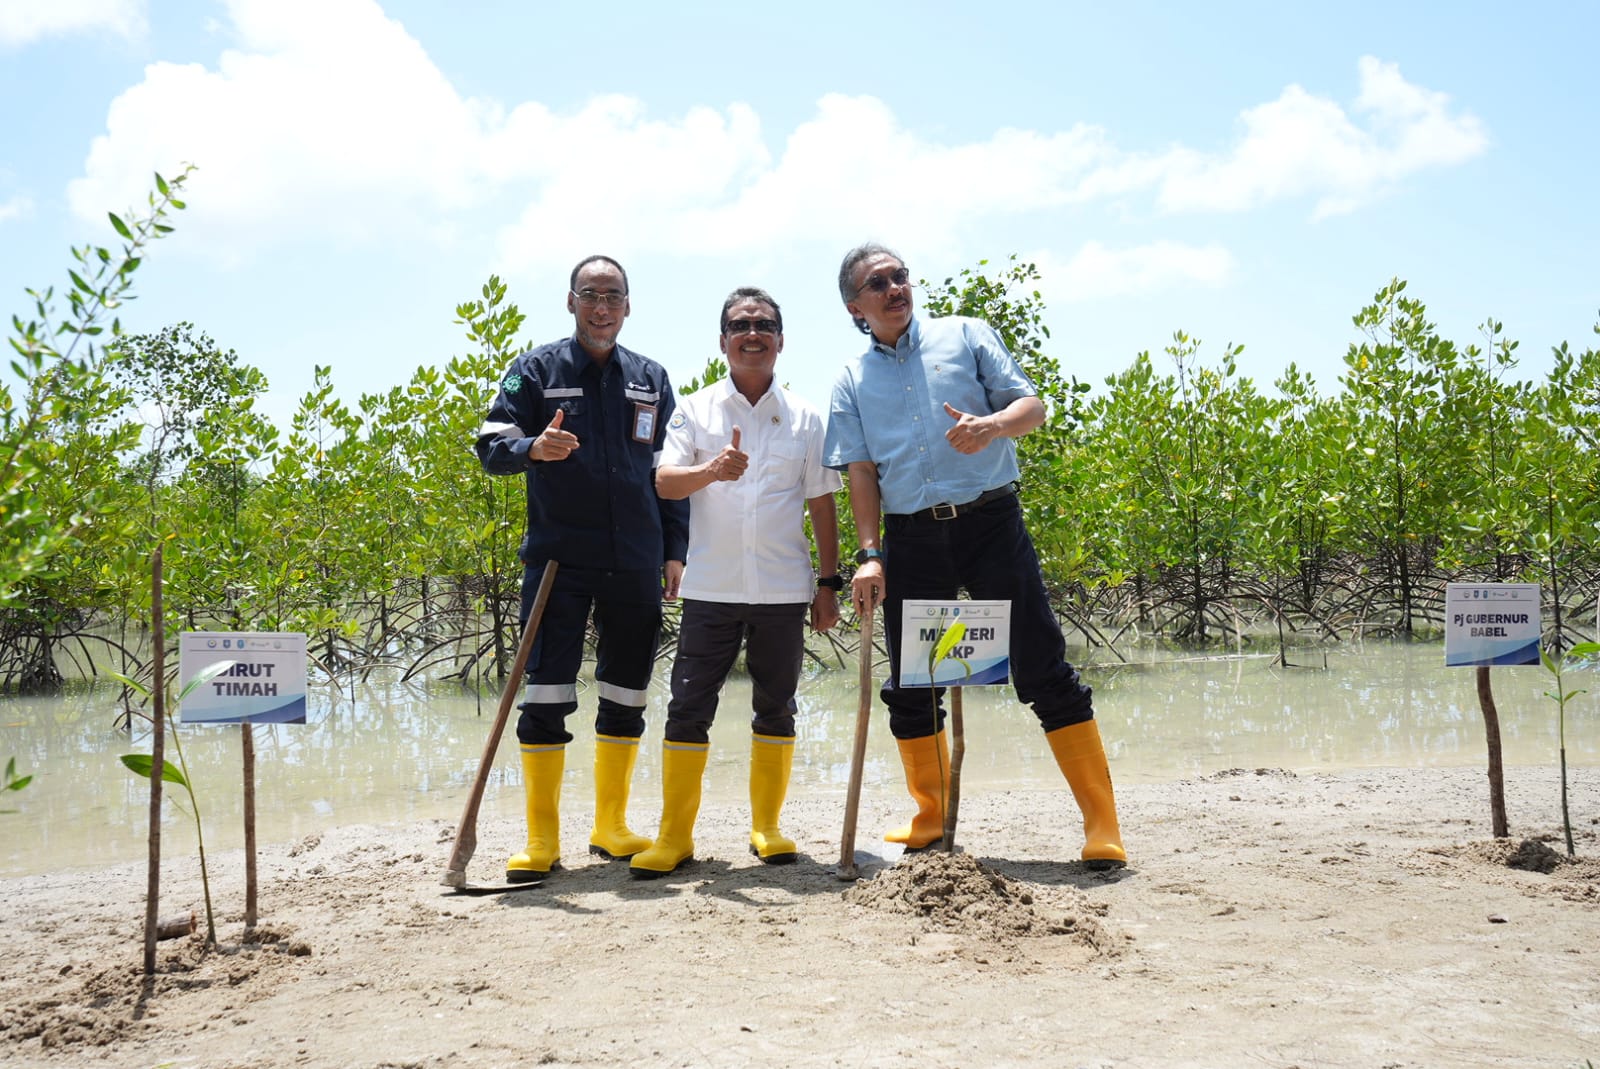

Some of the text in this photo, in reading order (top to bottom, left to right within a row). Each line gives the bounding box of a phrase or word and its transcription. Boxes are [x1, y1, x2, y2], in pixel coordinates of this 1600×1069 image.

[1454, 613, 1529, 627] Pj GUBERNUR
[919, 627, 995, 641] MTERI
[1470, 627, 1507, 637] BABEL
[943, 646, 975, 659] KP
[212, 682, 277, 697] TIMAH
